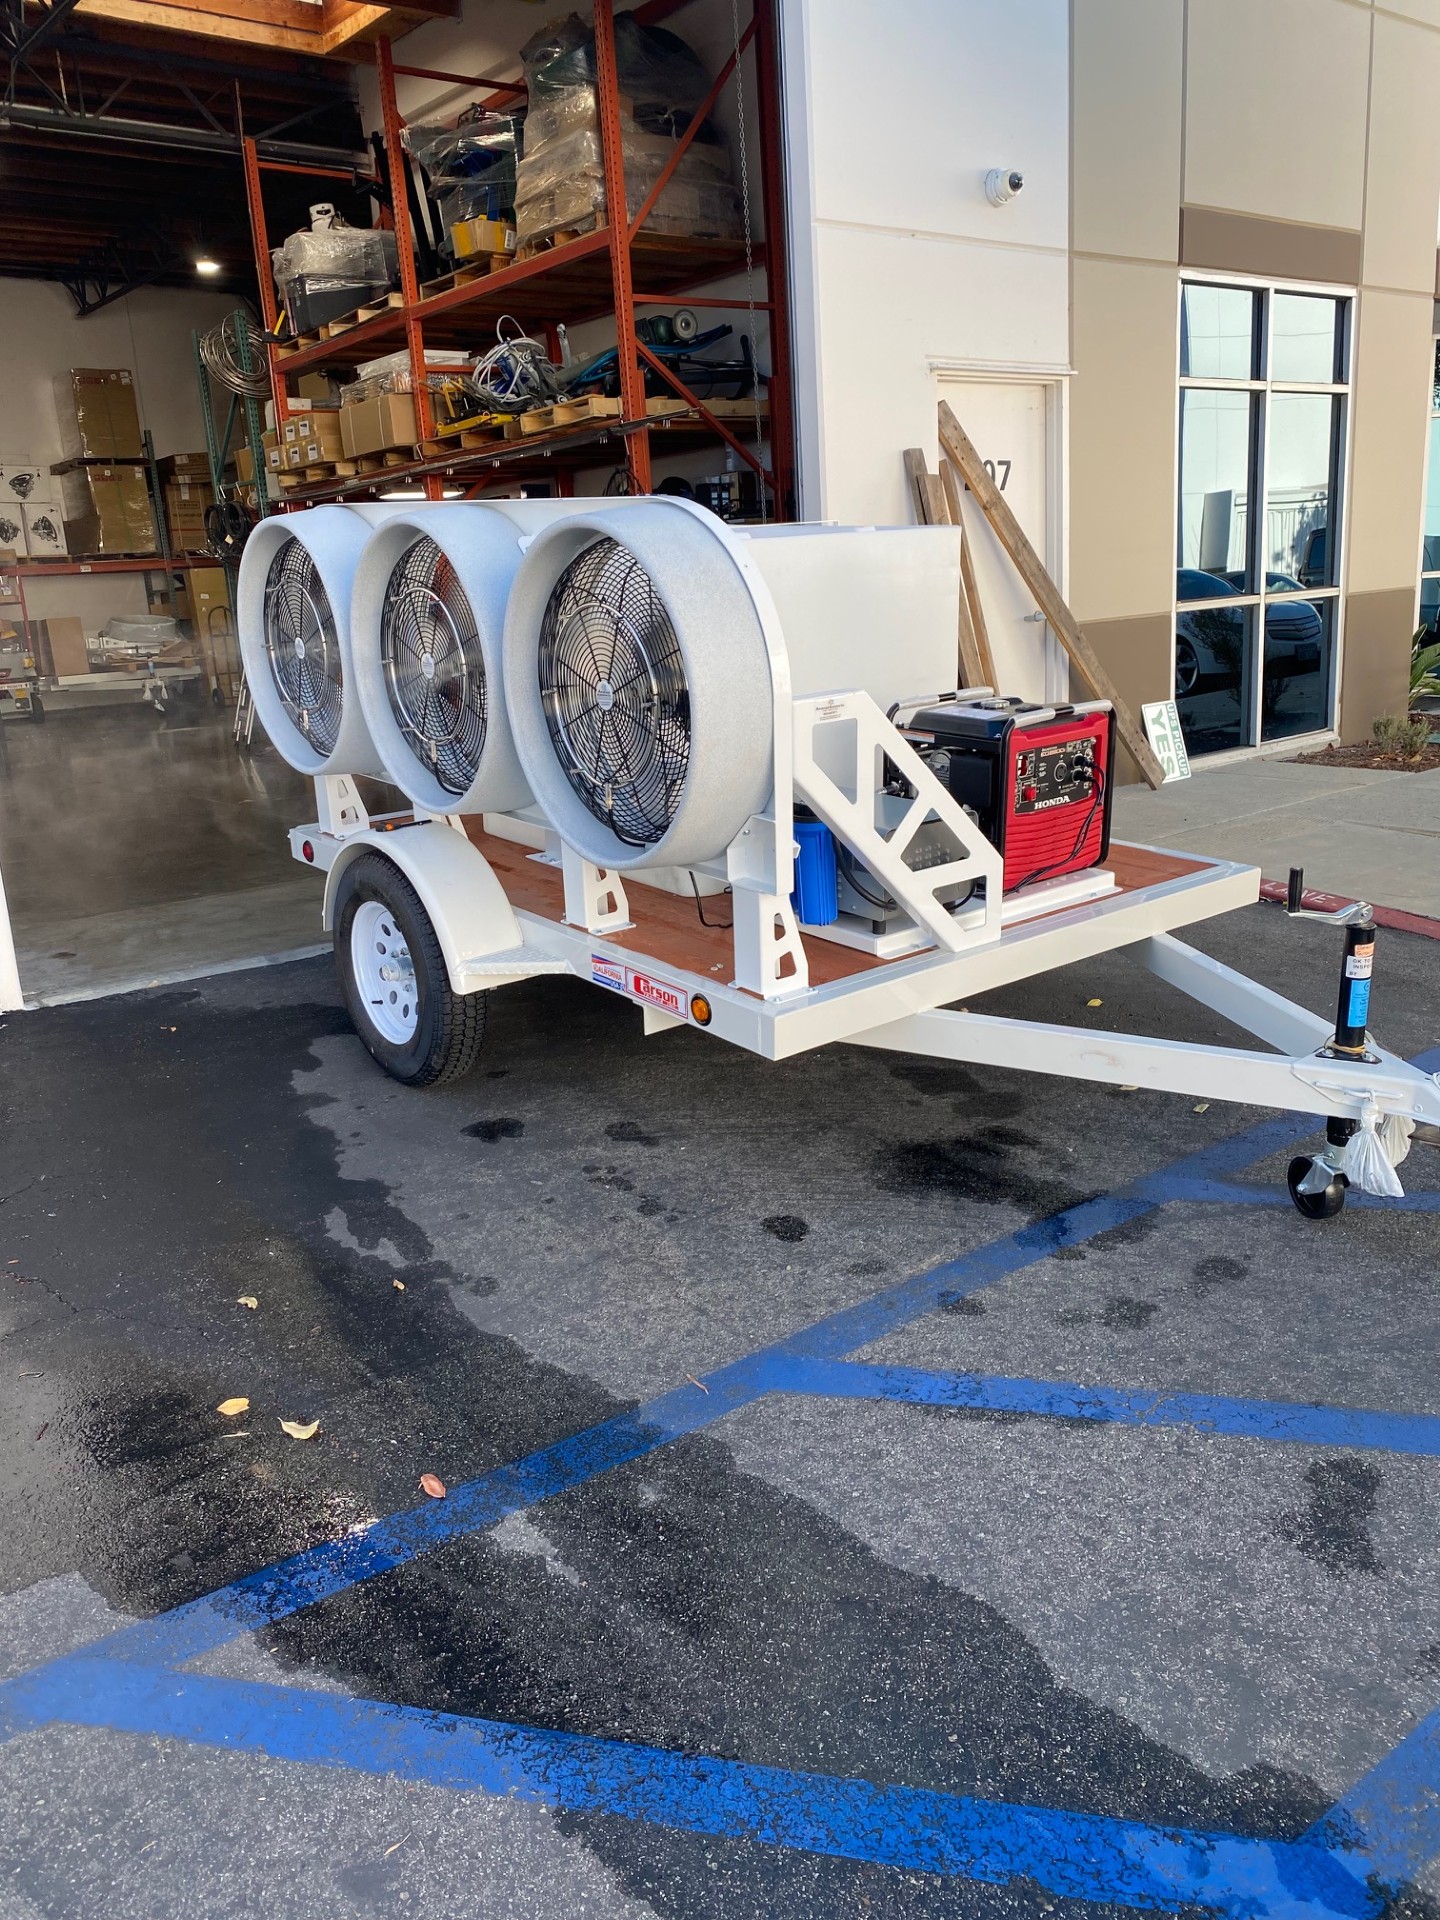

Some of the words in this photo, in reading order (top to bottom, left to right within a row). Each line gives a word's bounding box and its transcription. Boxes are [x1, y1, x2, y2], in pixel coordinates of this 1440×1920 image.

[1151, 708, 1175, 776] YES
[1166, 703, 1178, 728] UPS
[1172, 730, 1189, 775] PICKUP
[1034, 795, 1071, 810] HONDA
[593, 965, 622, 981] CALIFORNIA
[633, 975, 678, 1005] Carson
